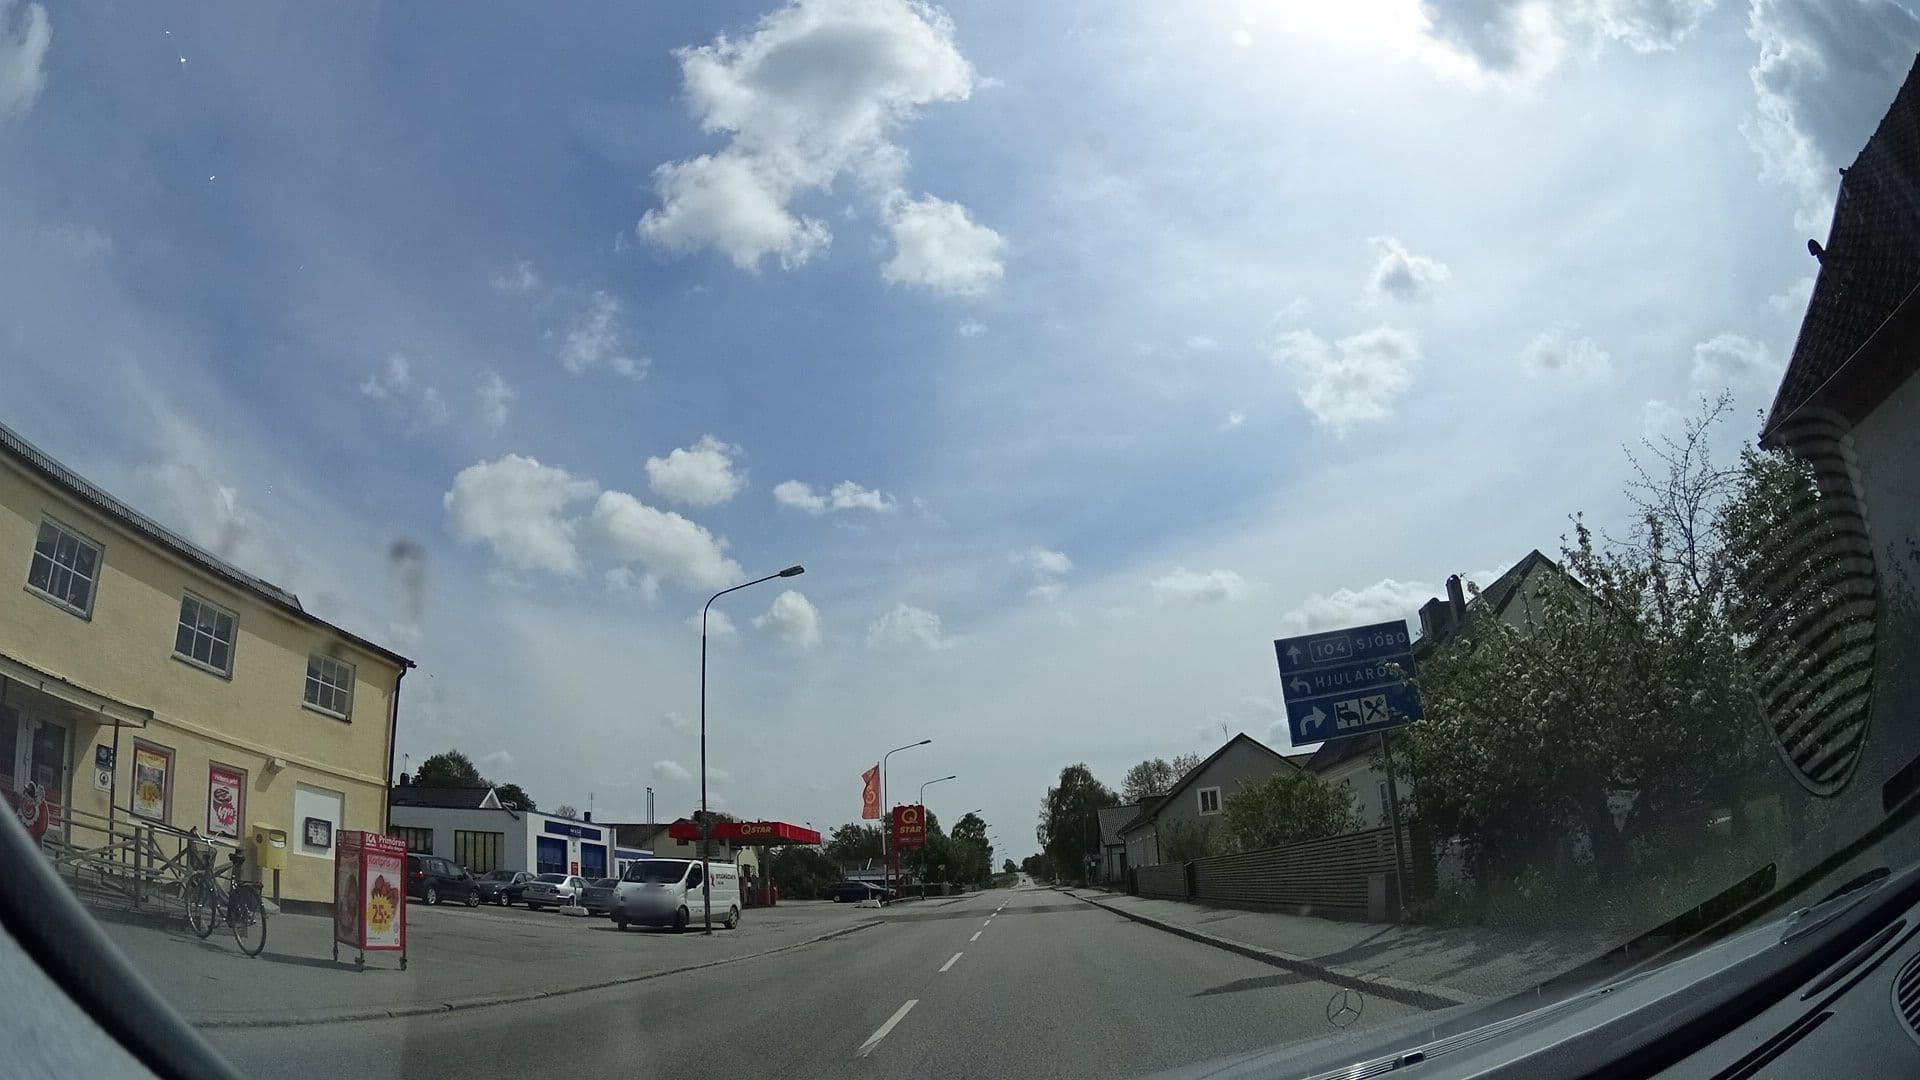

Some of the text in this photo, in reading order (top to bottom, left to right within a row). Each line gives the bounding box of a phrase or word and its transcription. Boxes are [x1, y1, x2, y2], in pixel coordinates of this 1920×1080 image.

[1317, 631, 1406, 656] 104 SJÖBO
[900, 825, 922, 834] STAR
[365, 833, 377, 843] ICA
